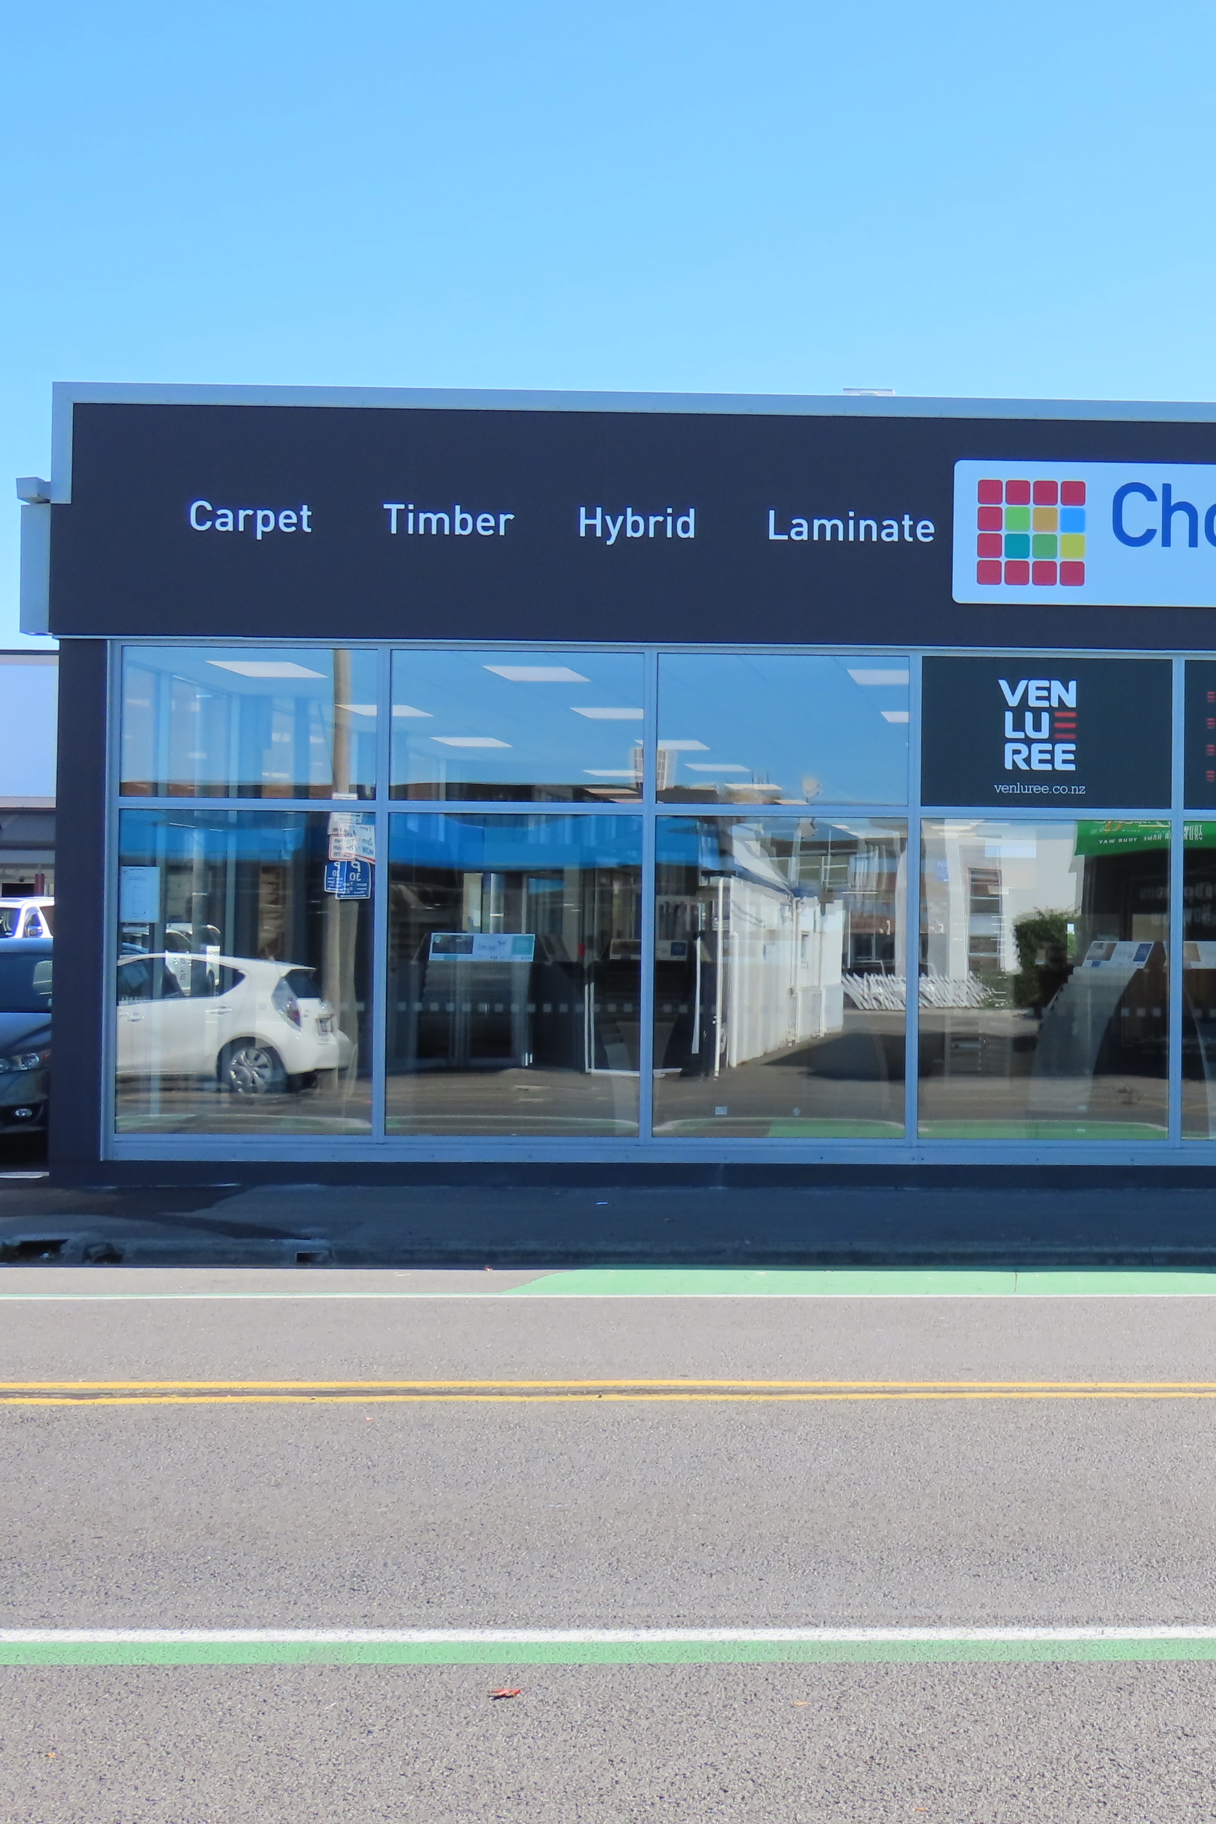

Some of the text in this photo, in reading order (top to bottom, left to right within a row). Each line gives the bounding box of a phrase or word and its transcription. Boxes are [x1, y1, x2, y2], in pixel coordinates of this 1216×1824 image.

[188, 500, 313, 541] Carpet
[383, 503, 515, 537] Timber
[578, 506, 697, 546] Hybrid
[768, 508, 936, 544] Laminate
[998, 679, 1077, 709] VEN
[1004, 742, 1077, 772] REE
[993, 782, 1087, 796] venluree.co.nz
